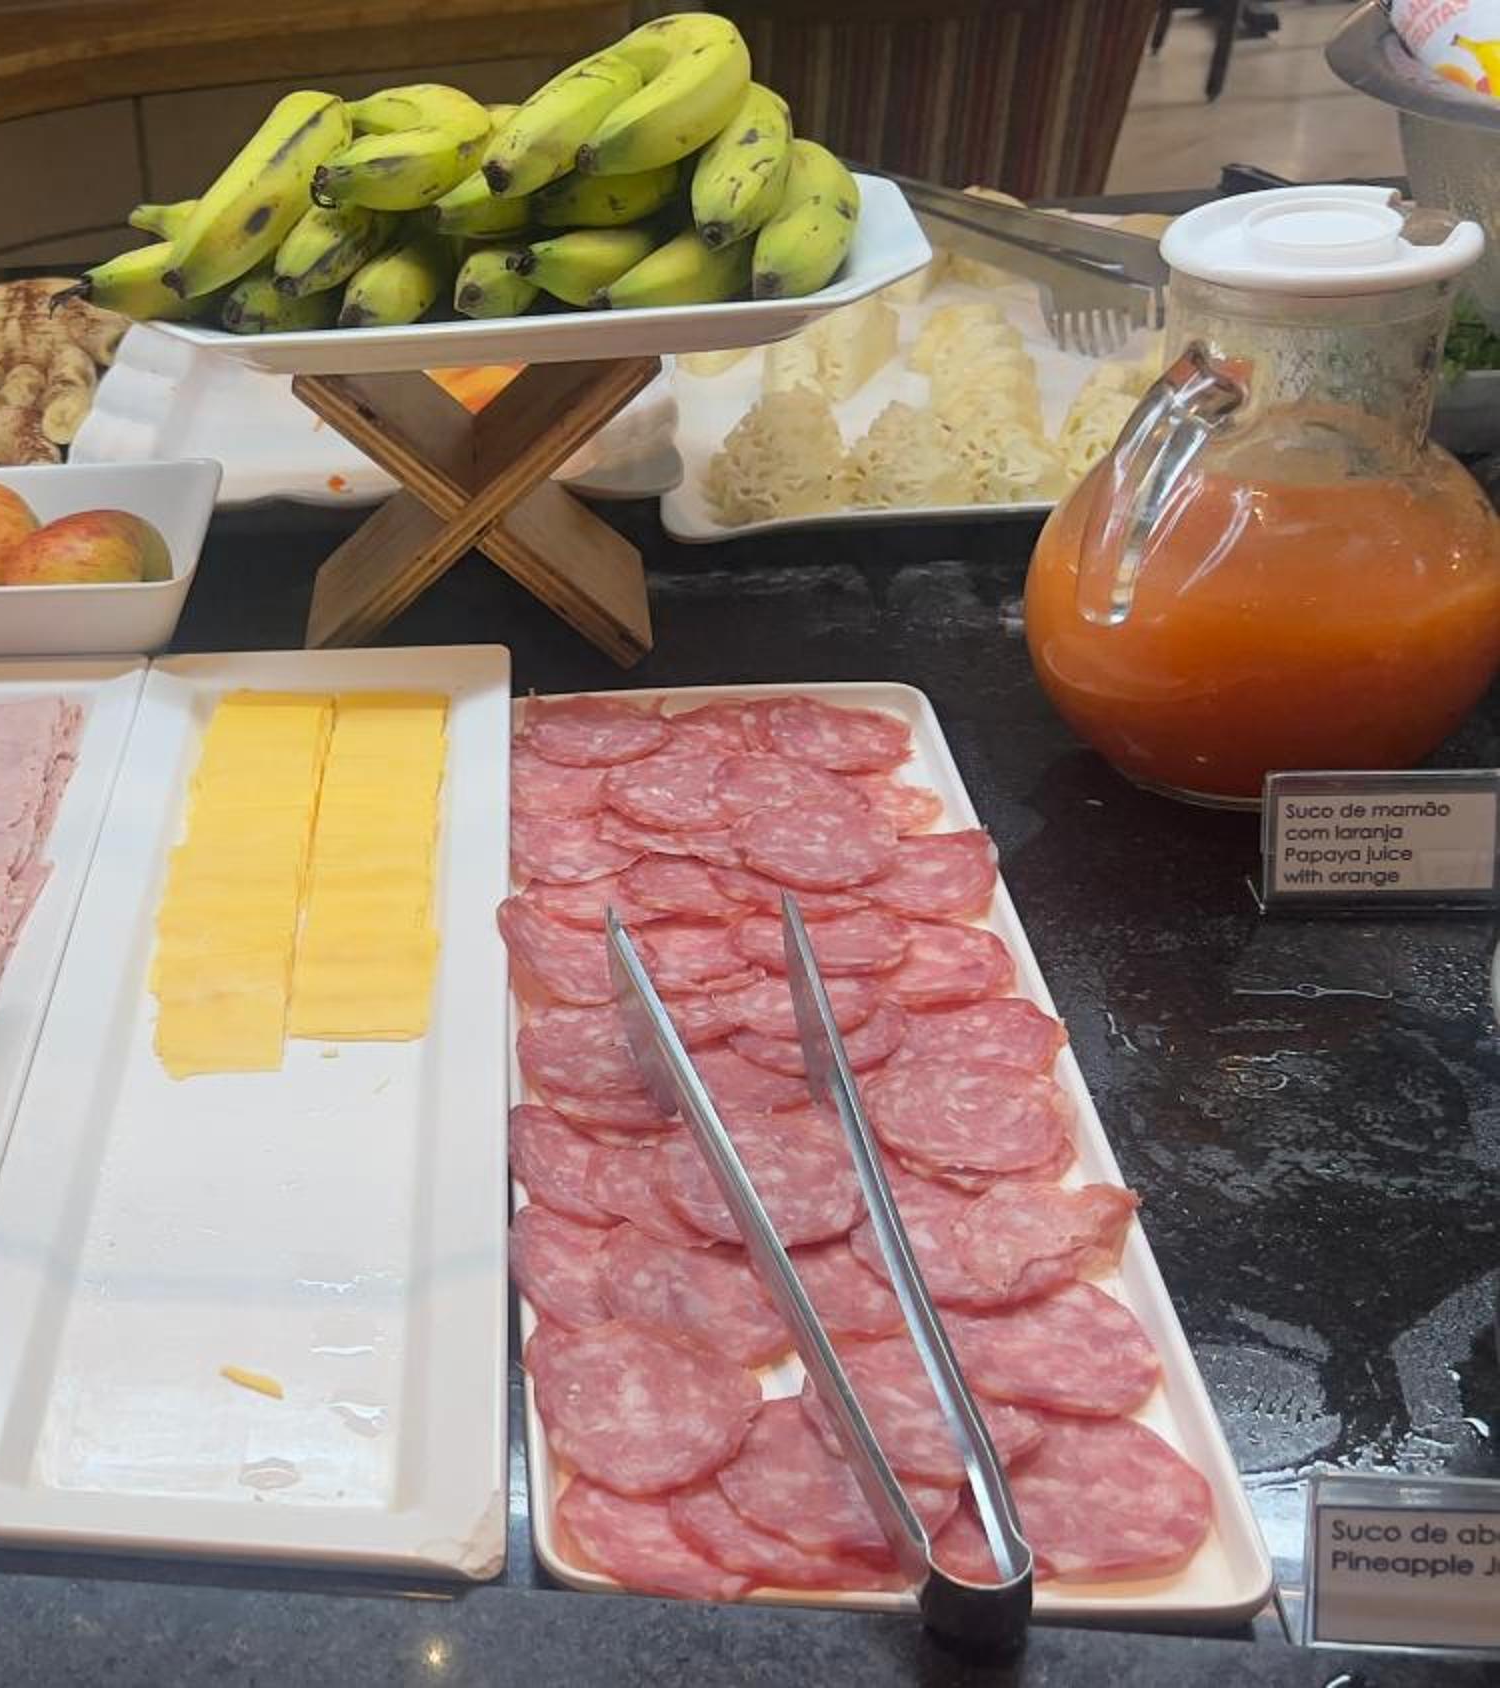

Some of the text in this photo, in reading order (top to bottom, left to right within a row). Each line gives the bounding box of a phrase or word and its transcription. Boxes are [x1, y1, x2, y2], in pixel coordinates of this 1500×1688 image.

[1285, 802, 1450, 819] Suco de mamão
[1285, 824, 1404, 842] com laranja
[1284, 845, 1413, 865] Papaya juice
[1284, 868, 1400, 886] with orange
[1331, 1520, 1500, 1545] Suco de ab
[1331, 1551, 1474, 1578] Pineapple
